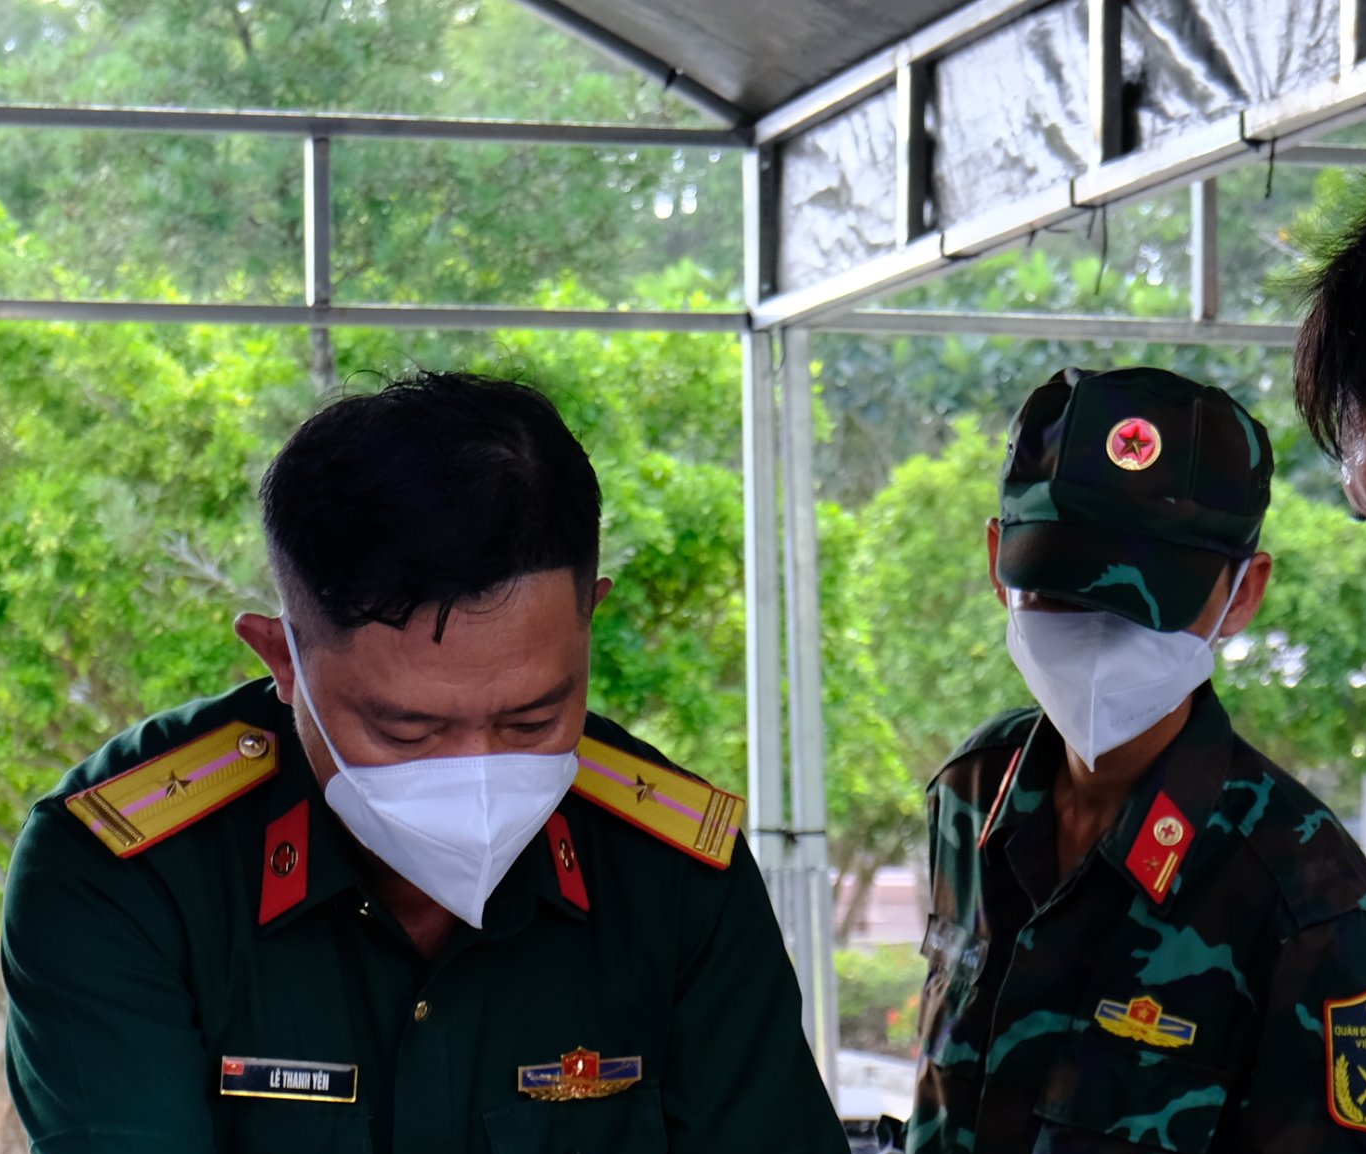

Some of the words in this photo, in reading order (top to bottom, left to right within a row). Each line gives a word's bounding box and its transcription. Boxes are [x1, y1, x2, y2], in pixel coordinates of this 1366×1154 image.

[1334, 1025, 1358, 1037] QUÂN
[270, 1068, 281, 1088] LÊ
[283, 1071, 311, 1090] THANH
[313, 1070, 330, 1091] YÊN
